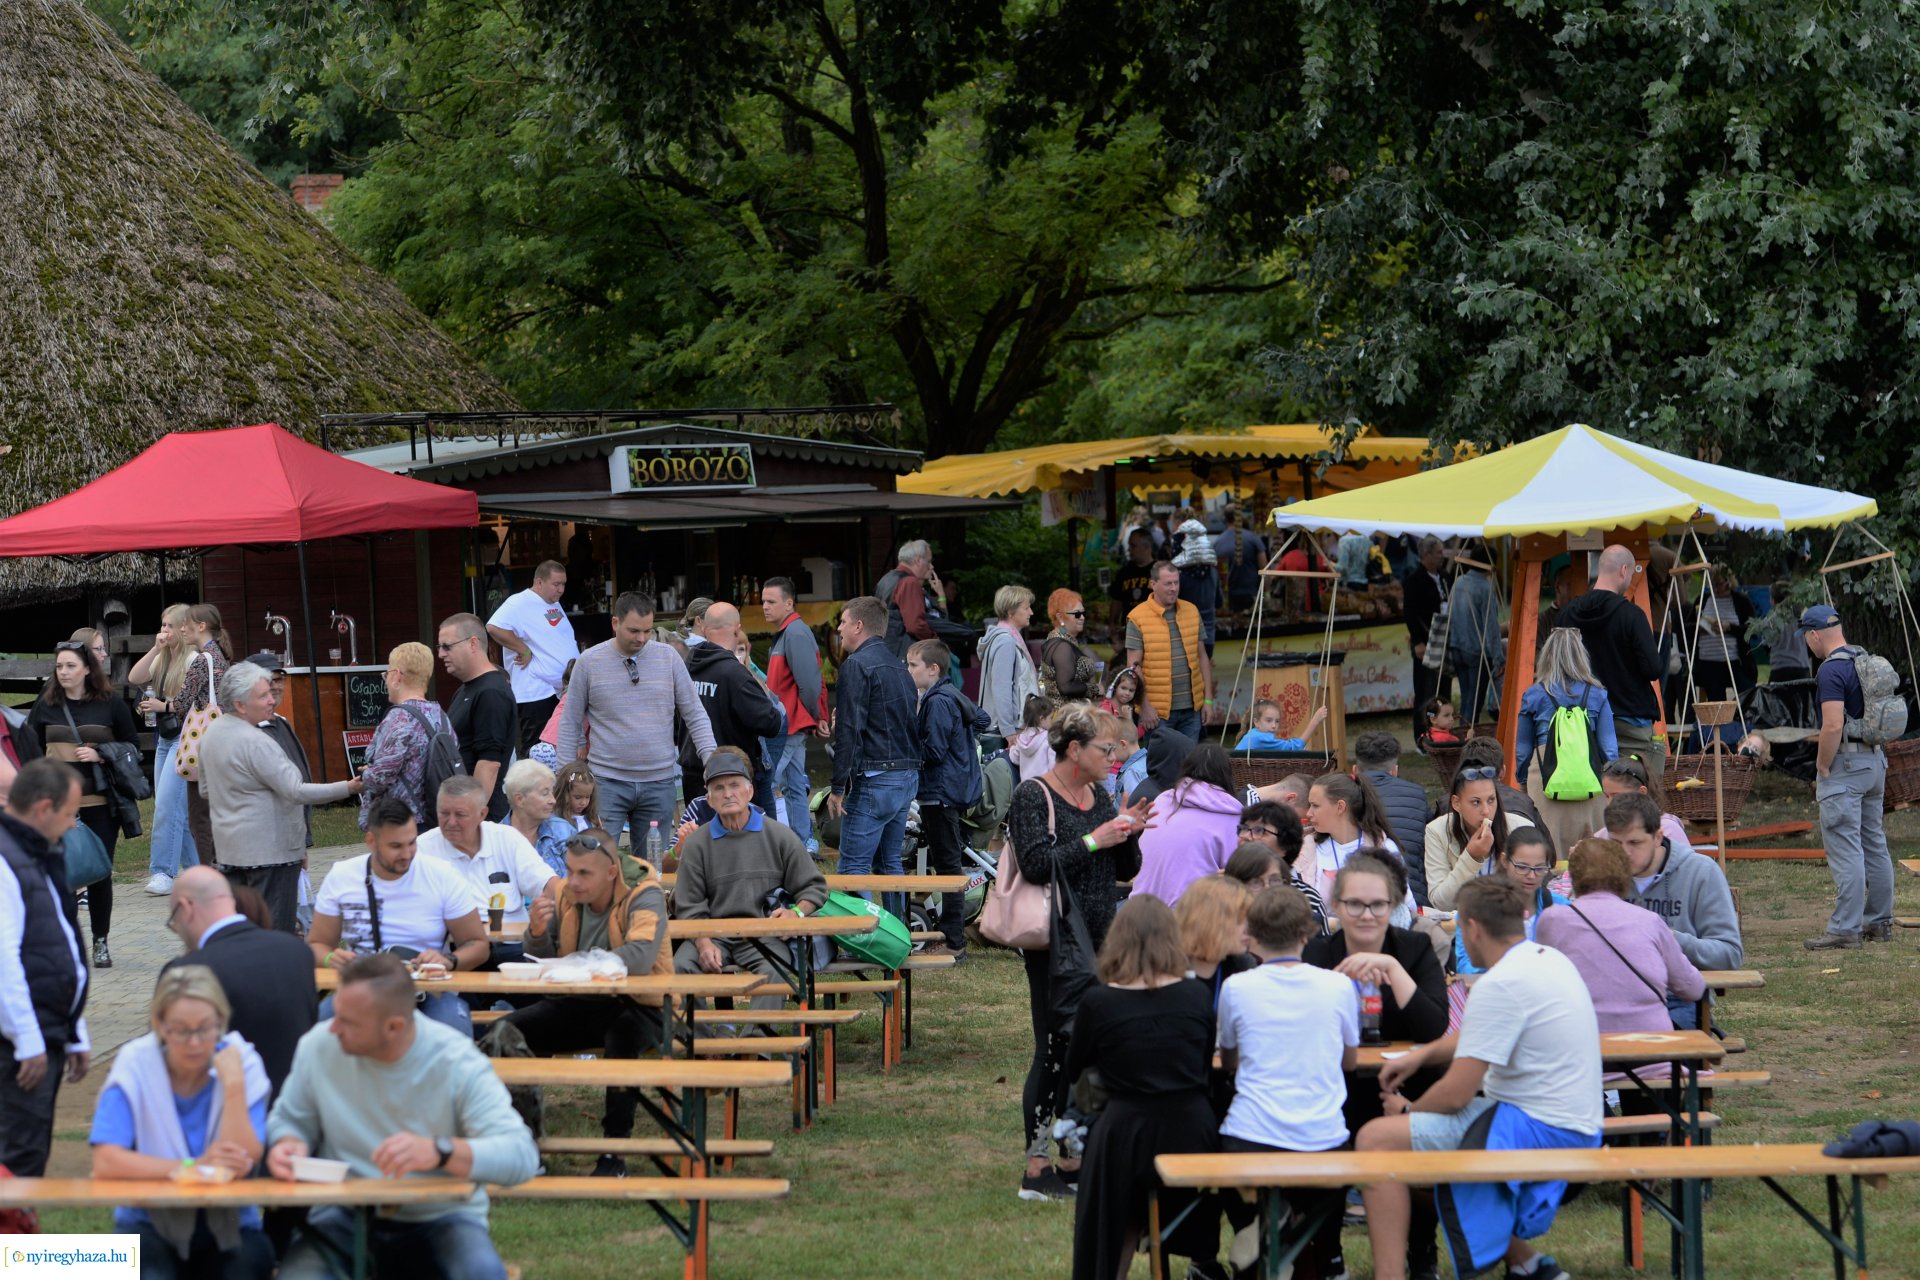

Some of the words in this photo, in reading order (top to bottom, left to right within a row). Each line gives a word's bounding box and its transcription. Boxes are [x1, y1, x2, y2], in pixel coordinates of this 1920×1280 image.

[692, 680, 718, 697] RITY
[361, 700, 381, 717] Sör
[347, 732, 374, 745] ÁRTÁBL
[351, 753, 367, 764] Kors
[1644, 898, 1682, 917] TOOLS
